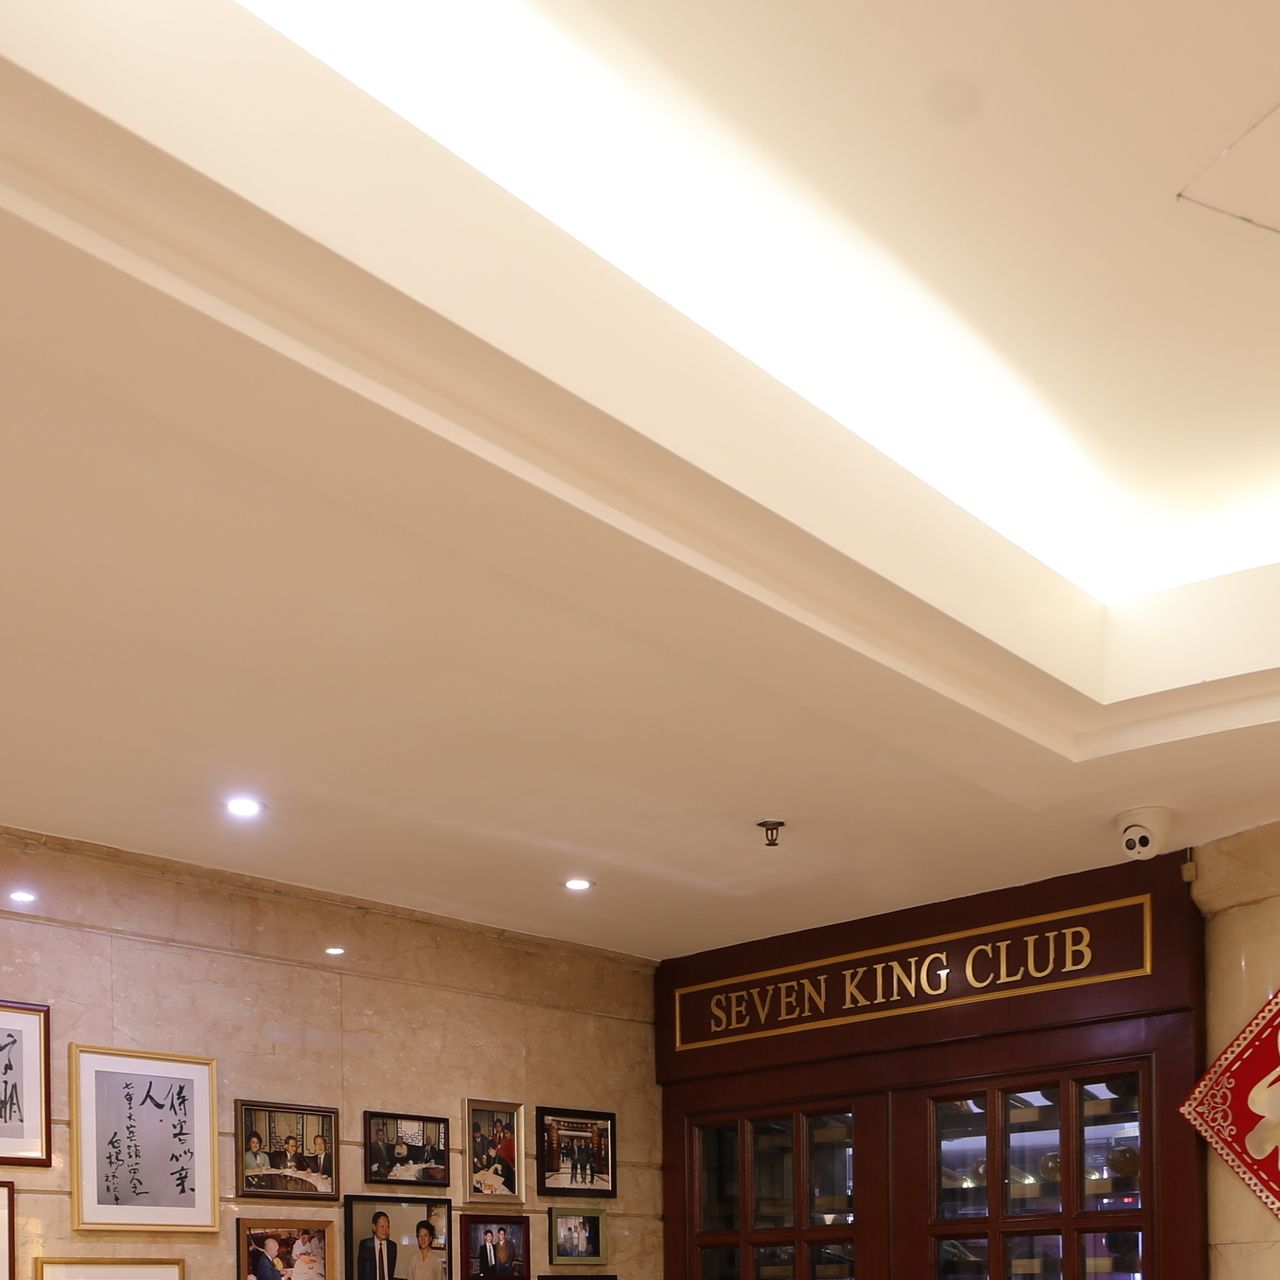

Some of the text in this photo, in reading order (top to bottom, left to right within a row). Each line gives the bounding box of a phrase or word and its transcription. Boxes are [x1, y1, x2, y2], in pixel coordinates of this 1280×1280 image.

[710, 926, 1093, 1034] SEVEN KING CLUB
